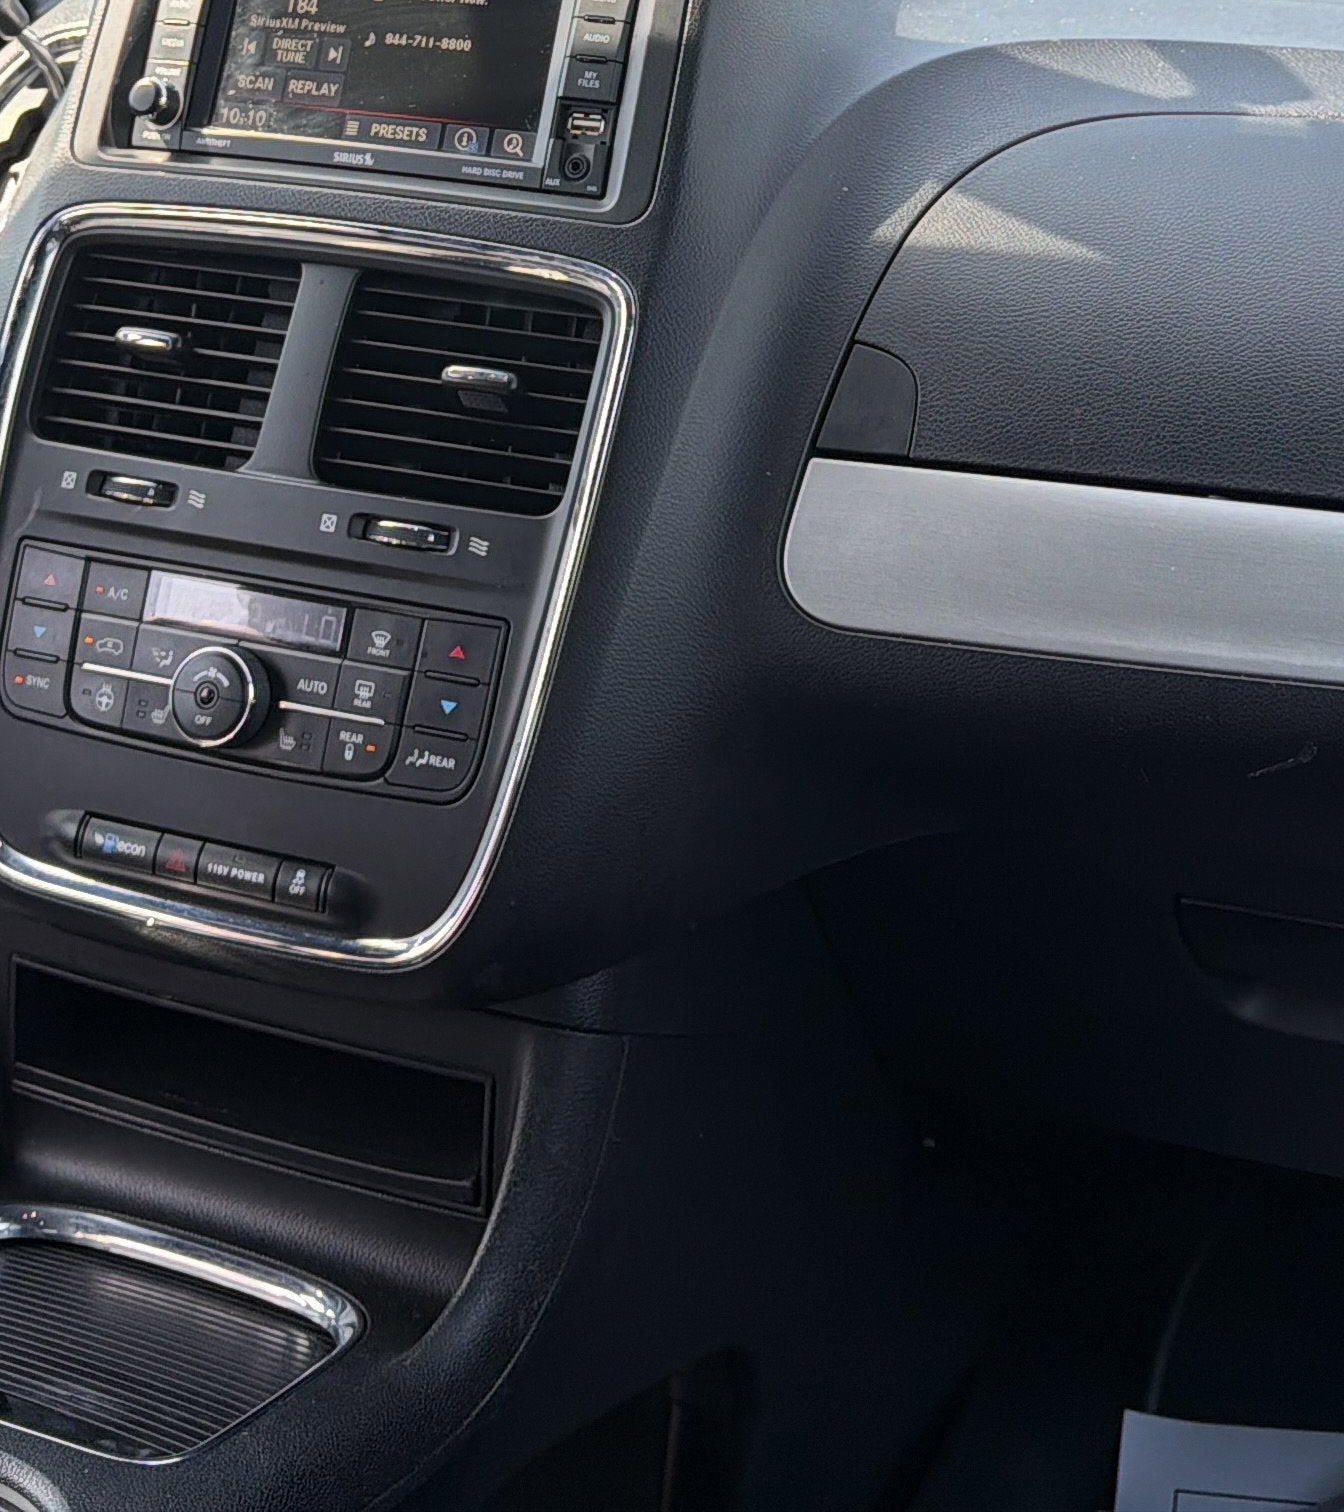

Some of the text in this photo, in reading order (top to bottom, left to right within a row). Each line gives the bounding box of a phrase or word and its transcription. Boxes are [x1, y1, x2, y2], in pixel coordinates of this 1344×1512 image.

[249, 14, 347, 34] SiriusXM Preview
[272, 37, 313, 52] DIRECT
[384, 32, 472, 52] 844-711-8800
[583, 33, 610, 43] AUDIO
[276, 50, 306, 64] TUNE
[584, 70, 598, 79] MY
[237, 74, 339, 96] SCAN REPLAY
[577, 78, 600, 89] FILES
[370, 123, 428, 142] PRESETS
[502, 169, 524, 180] DRIVE
[107, 586, 129, 600] A/C
[367, 646, 391, 658] FRONT
[25, 676, 51, 689] SYNC
[297, 678, 328, 695] AUTO
[194, 714, 213, 726] OFF
[339, 731, 364, 744] REAR
[428, 755, 455, 770] REAR
[116, 841, 146, 857] econ
[230, 866, 265, 884] POWER
[288, 884, 305, 896] OFF
